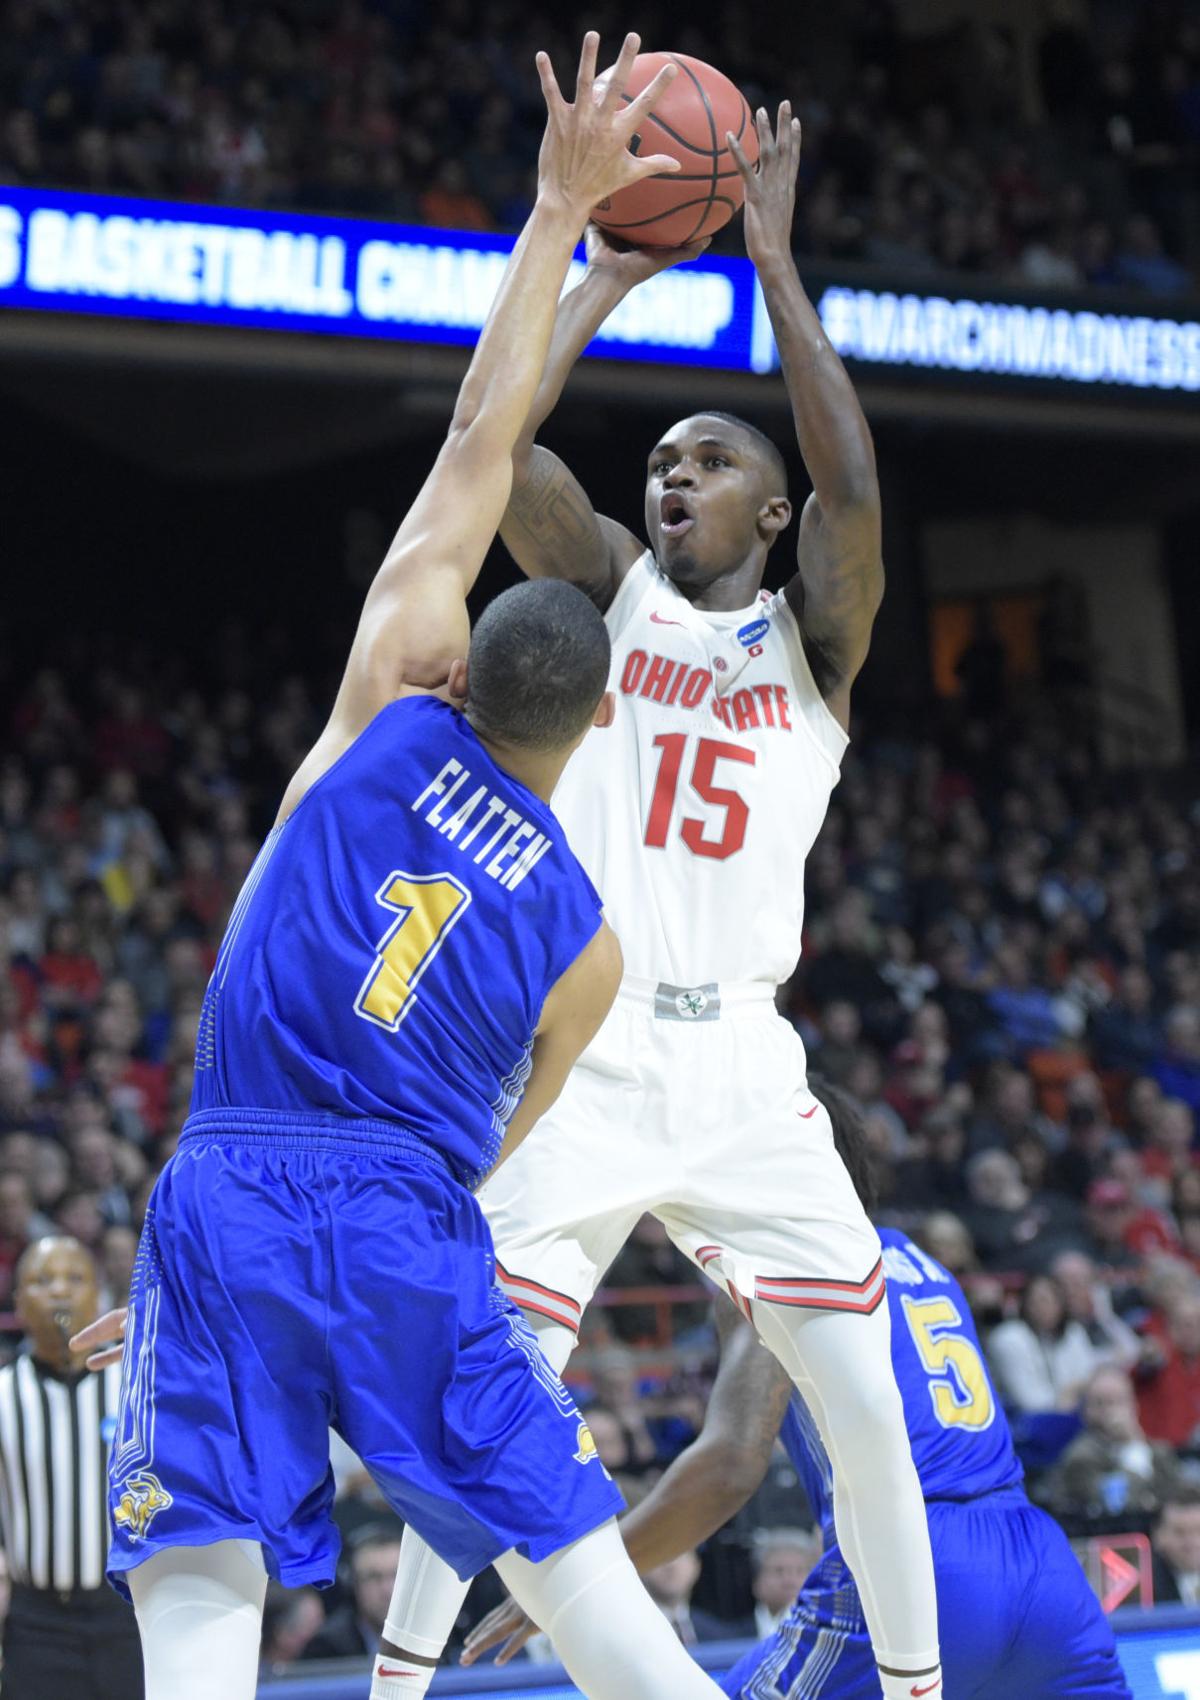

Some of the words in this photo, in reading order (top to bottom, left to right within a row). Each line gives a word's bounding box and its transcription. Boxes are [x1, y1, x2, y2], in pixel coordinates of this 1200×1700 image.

[28, 211, 349, 314] BASKETBALL
[820, 290, 1200, 389] #MARCHMADNESS
[619, 648, 712, 710] OHIO
[411, 757, 553, 892] FLATTEN
[643, 732, 756, 861] 15
[353, 870, 472, 1033] 1
[900, 1293, 996, 1432] 5
